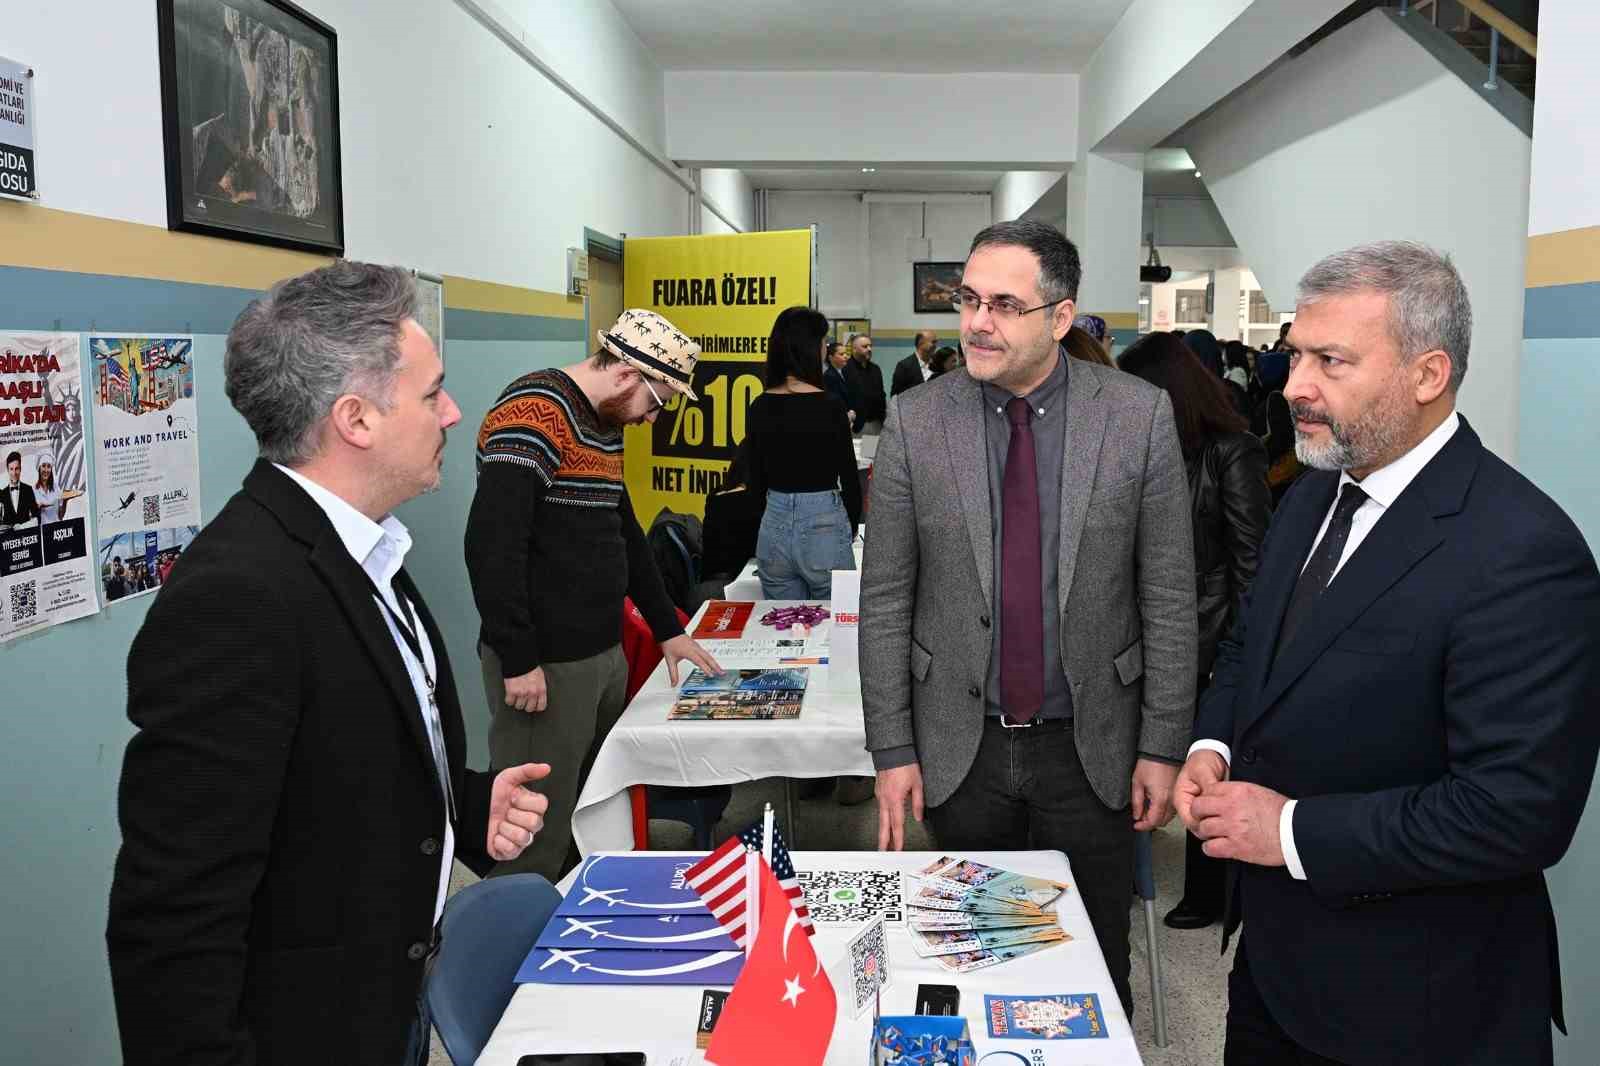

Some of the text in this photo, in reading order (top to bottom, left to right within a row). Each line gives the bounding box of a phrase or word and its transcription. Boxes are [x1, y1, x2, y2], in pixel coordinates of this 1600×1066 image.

[14, 81, 24, 95] VE
[1, 172, 28, 192] OSU
[652, 272, 777, 306] FUARA ÖZEL!
[760, 336, 769, 353] E
[103, 430, 187, 449] WORK AND TRAVEL
[652, 466, 685, 492] NET
